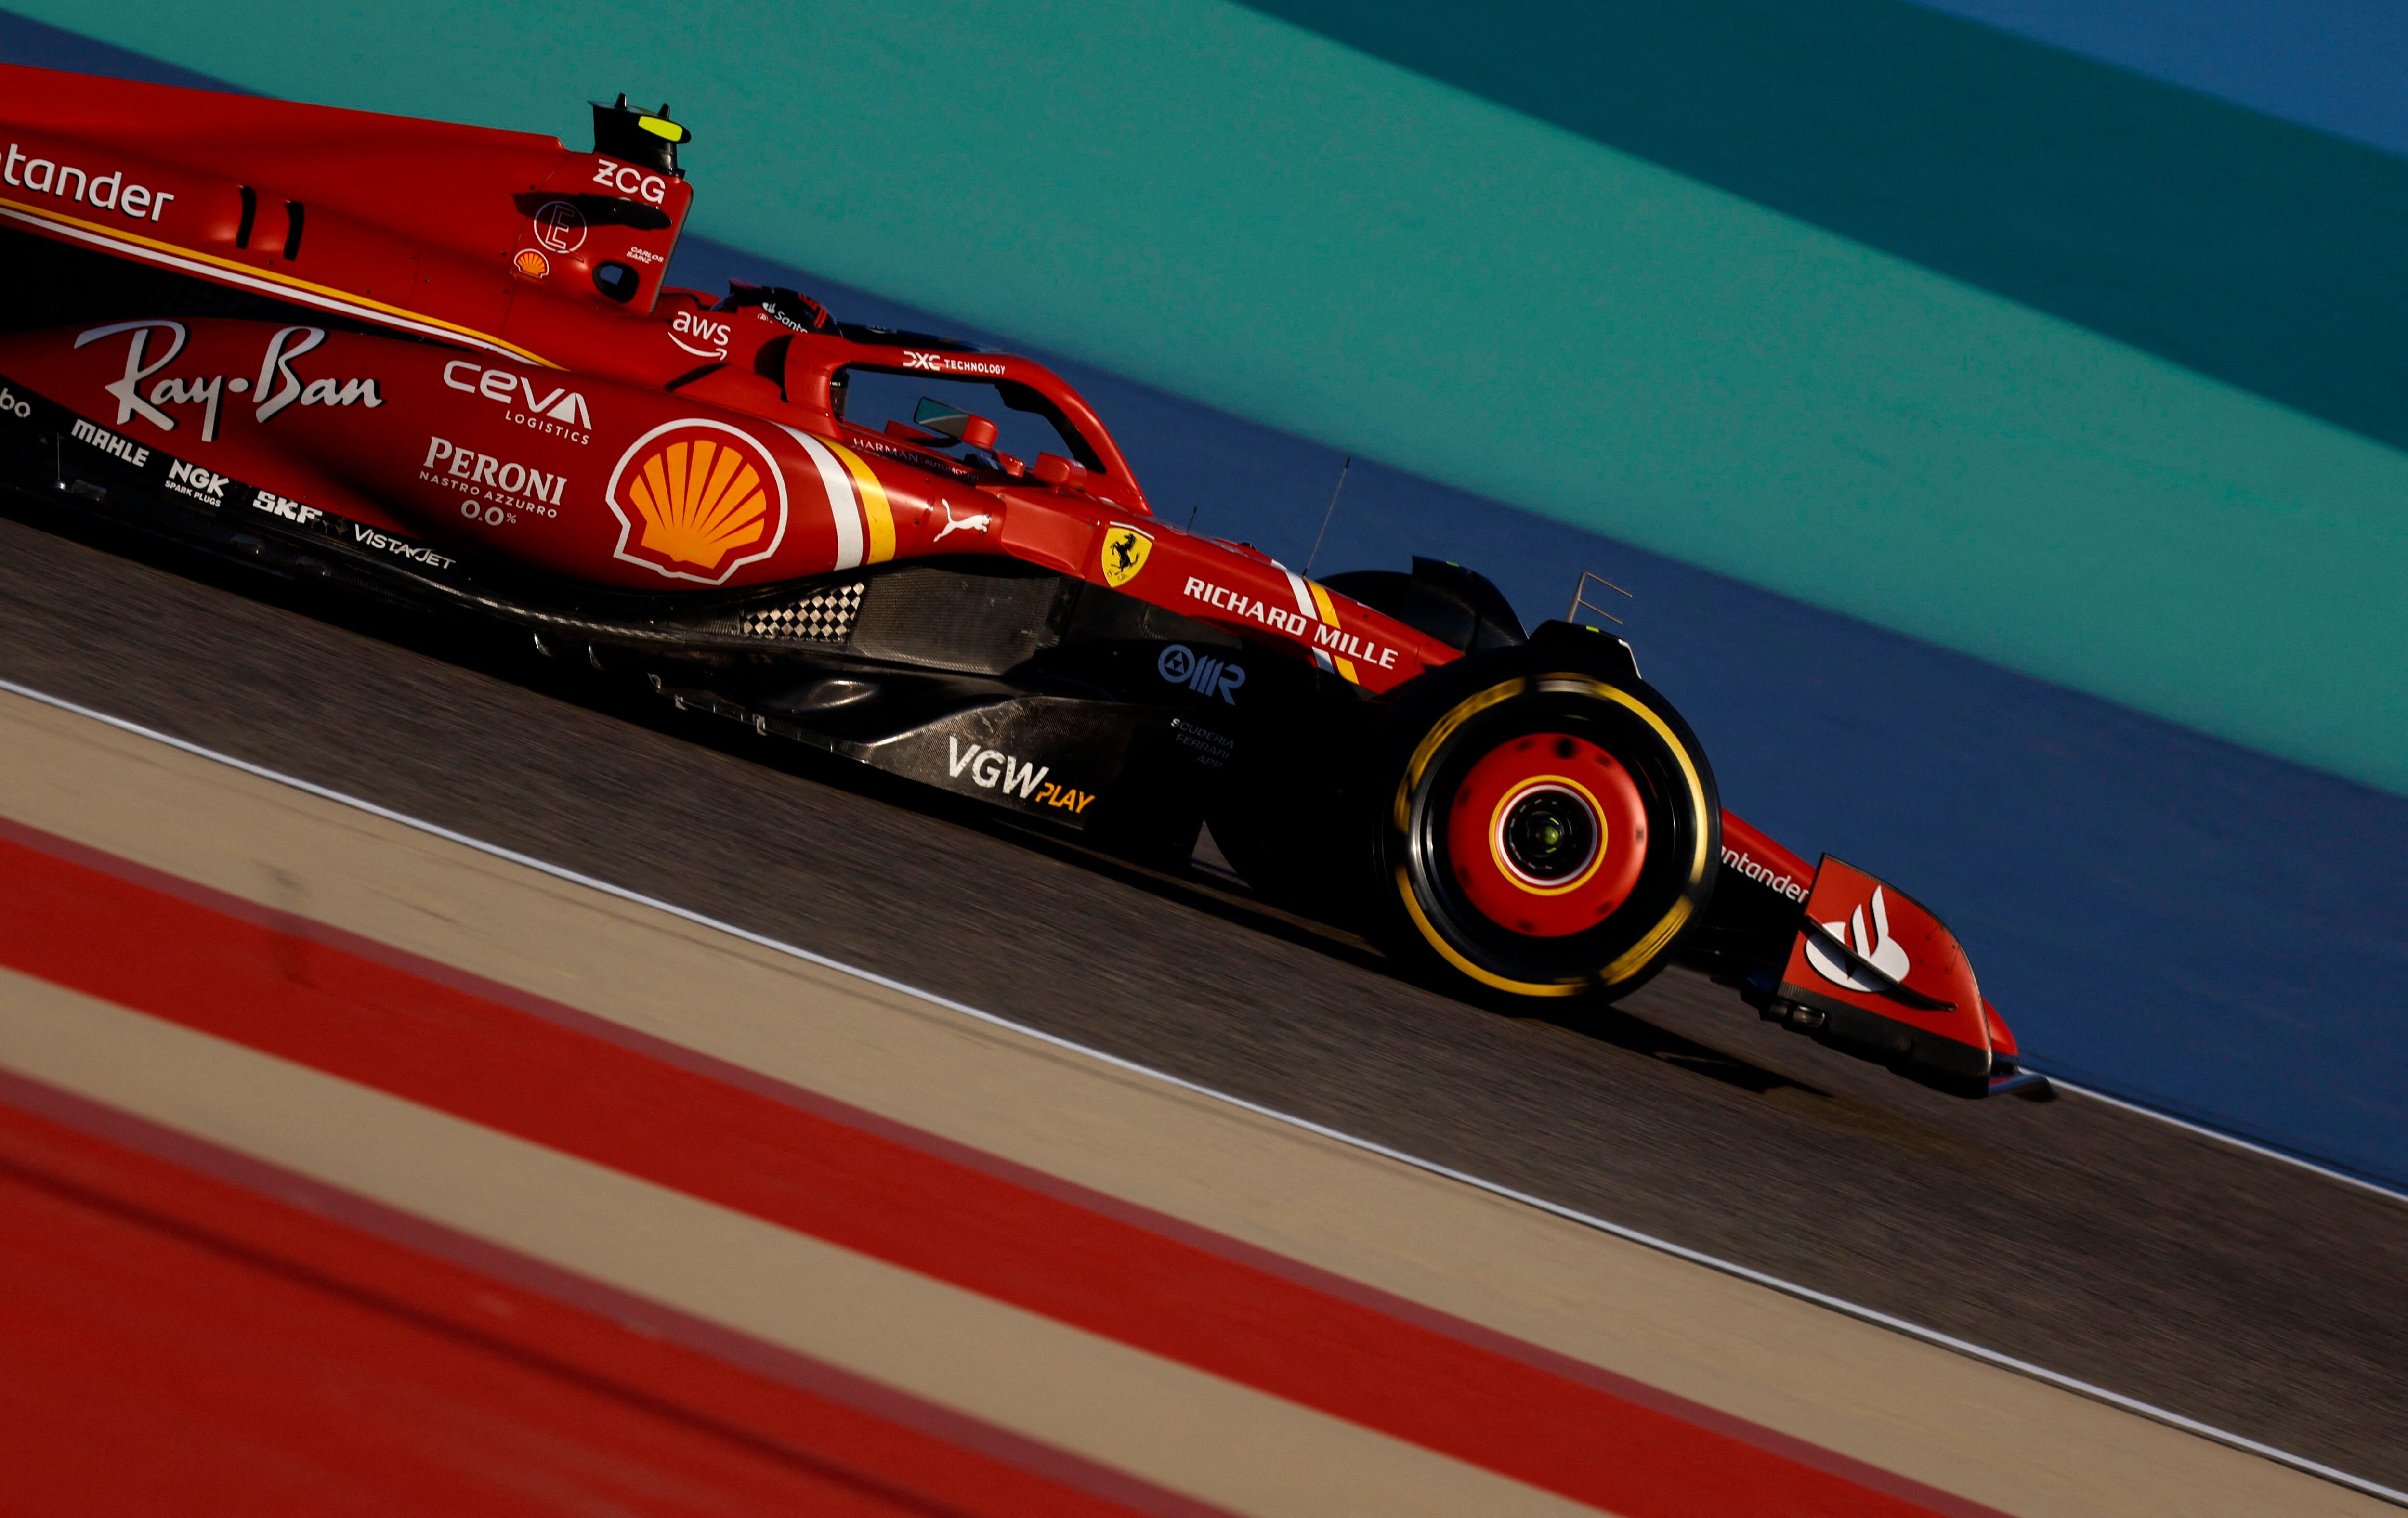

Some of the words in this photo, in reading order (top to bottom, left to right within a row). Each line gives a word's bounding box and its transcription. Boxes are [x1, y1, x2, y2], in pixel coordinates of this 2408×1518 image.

[0, 143, 174, 221] tander
[593, 159, 666, 204] ZCG
[627, 251, 652, 265] SAINZ
[631, 246, 664, 263] CARLOS
[672, 311, 731, 346] aws
[903, 350, 941, 371] DXC
[944, 359, 1005, 375] TECHNOLOGY
[71, 418, 150, 467] MAHLE
[506, 410, 591, 445] LOGISTICS
[853, 438, 918, 463] HARMAN
[169, 458, 229, 498] NGK
[423, 436, 567, 506] PERONI
[165, 480, 192, 496] SPARK
[193, 491, 222, 507] PLUGS
[252, 490, 323, 524] SKF
[419, 470, 480, 495] NASTRO
[484, 491, 557, 518] AZZURRO
[461, 499, 517, 526] 0.0%
[355, 524, 456, 569] VISTAJET
[1184, 576, 1308, 636] RICHARD
[1314, 623, 1398, 670] MILLE
[1171, 718, 1233, 749] SCUDERIA
[1176, 733, 1229, 759] FERRARI
[949, 735, 1049, 799] VGW
[1035, 782, 1096, 814] PLAY
[1195, 755, 1222, 768] APP
